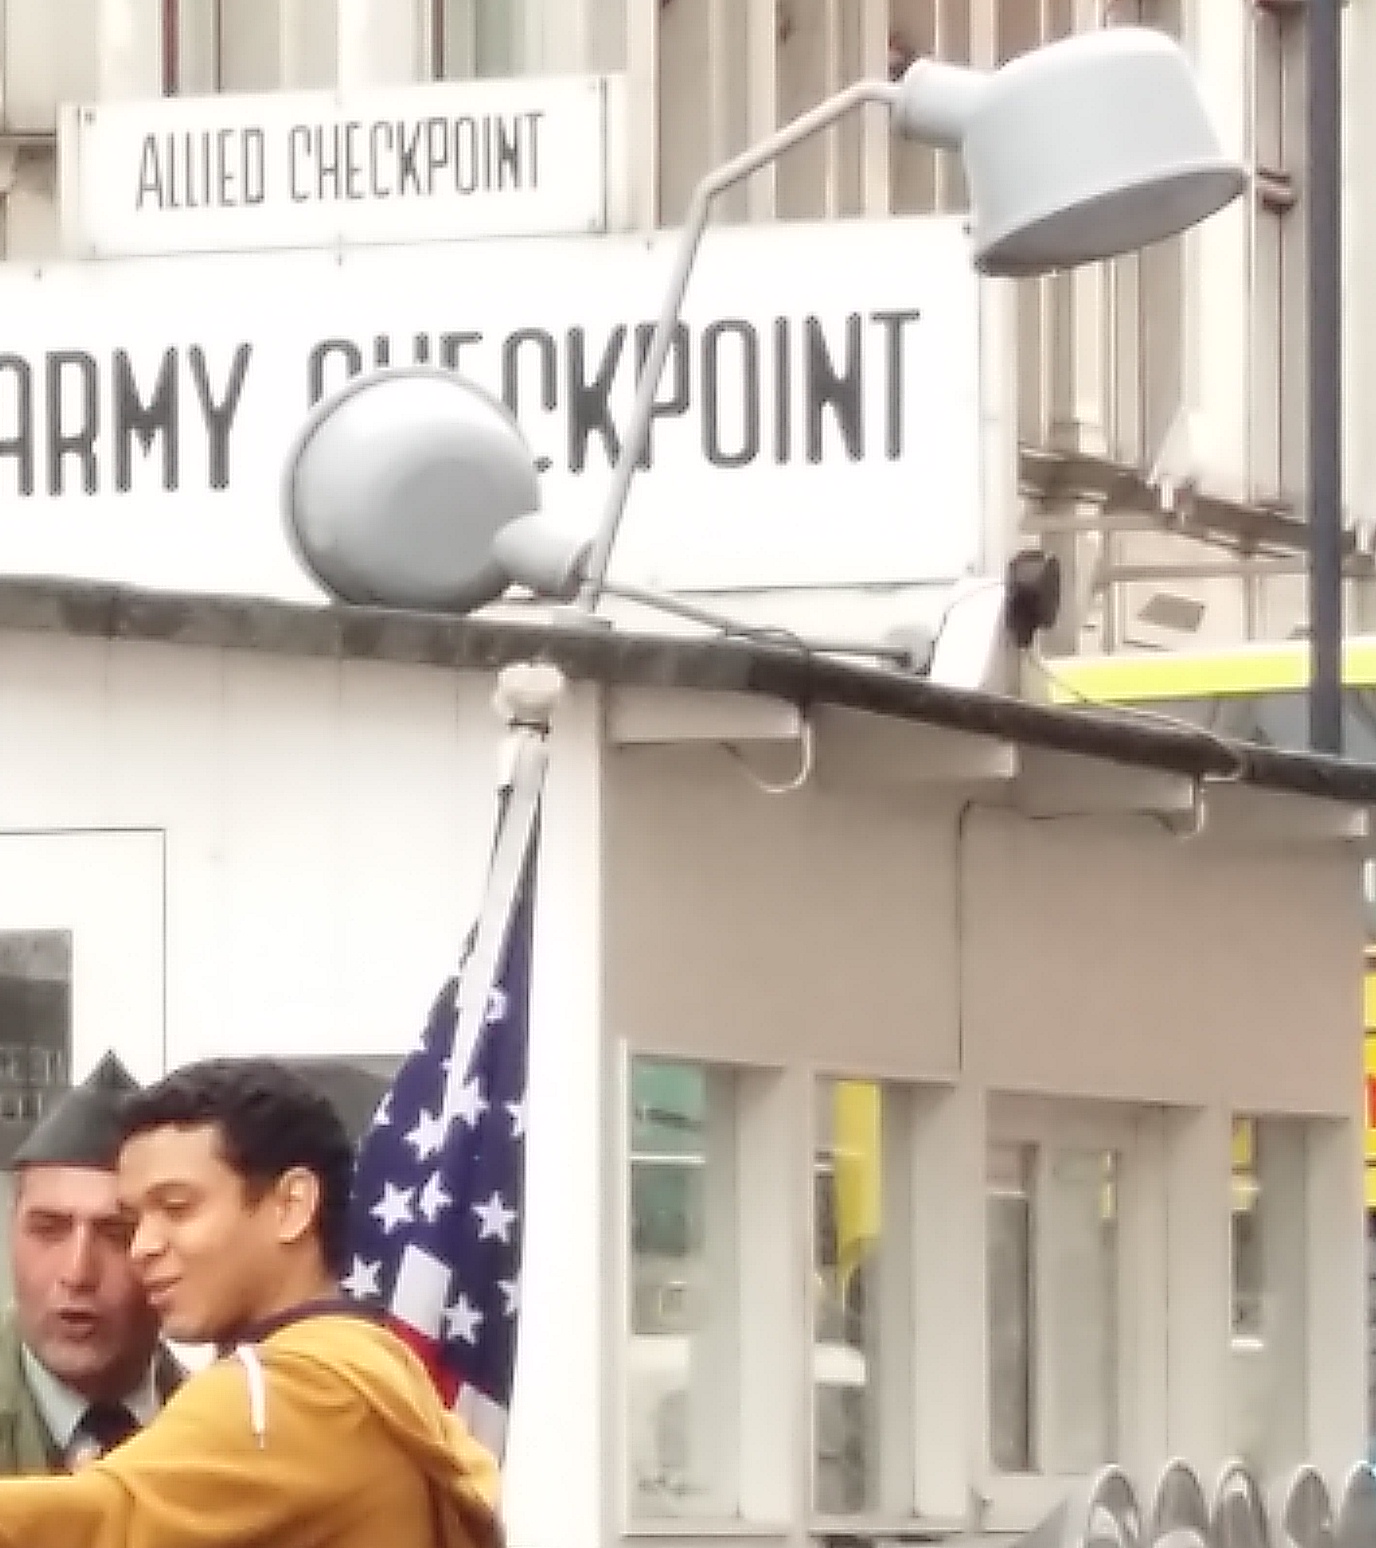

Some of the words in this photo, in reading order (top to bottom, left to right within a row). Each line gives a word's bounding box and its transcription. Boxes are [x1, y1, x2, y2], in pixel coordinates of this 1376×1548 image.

[136, 124, 266, 211] ALLIED
[288, 109, 544, 205] CHECKPOINT
[306, 309, 921, 482] CKPOINT
